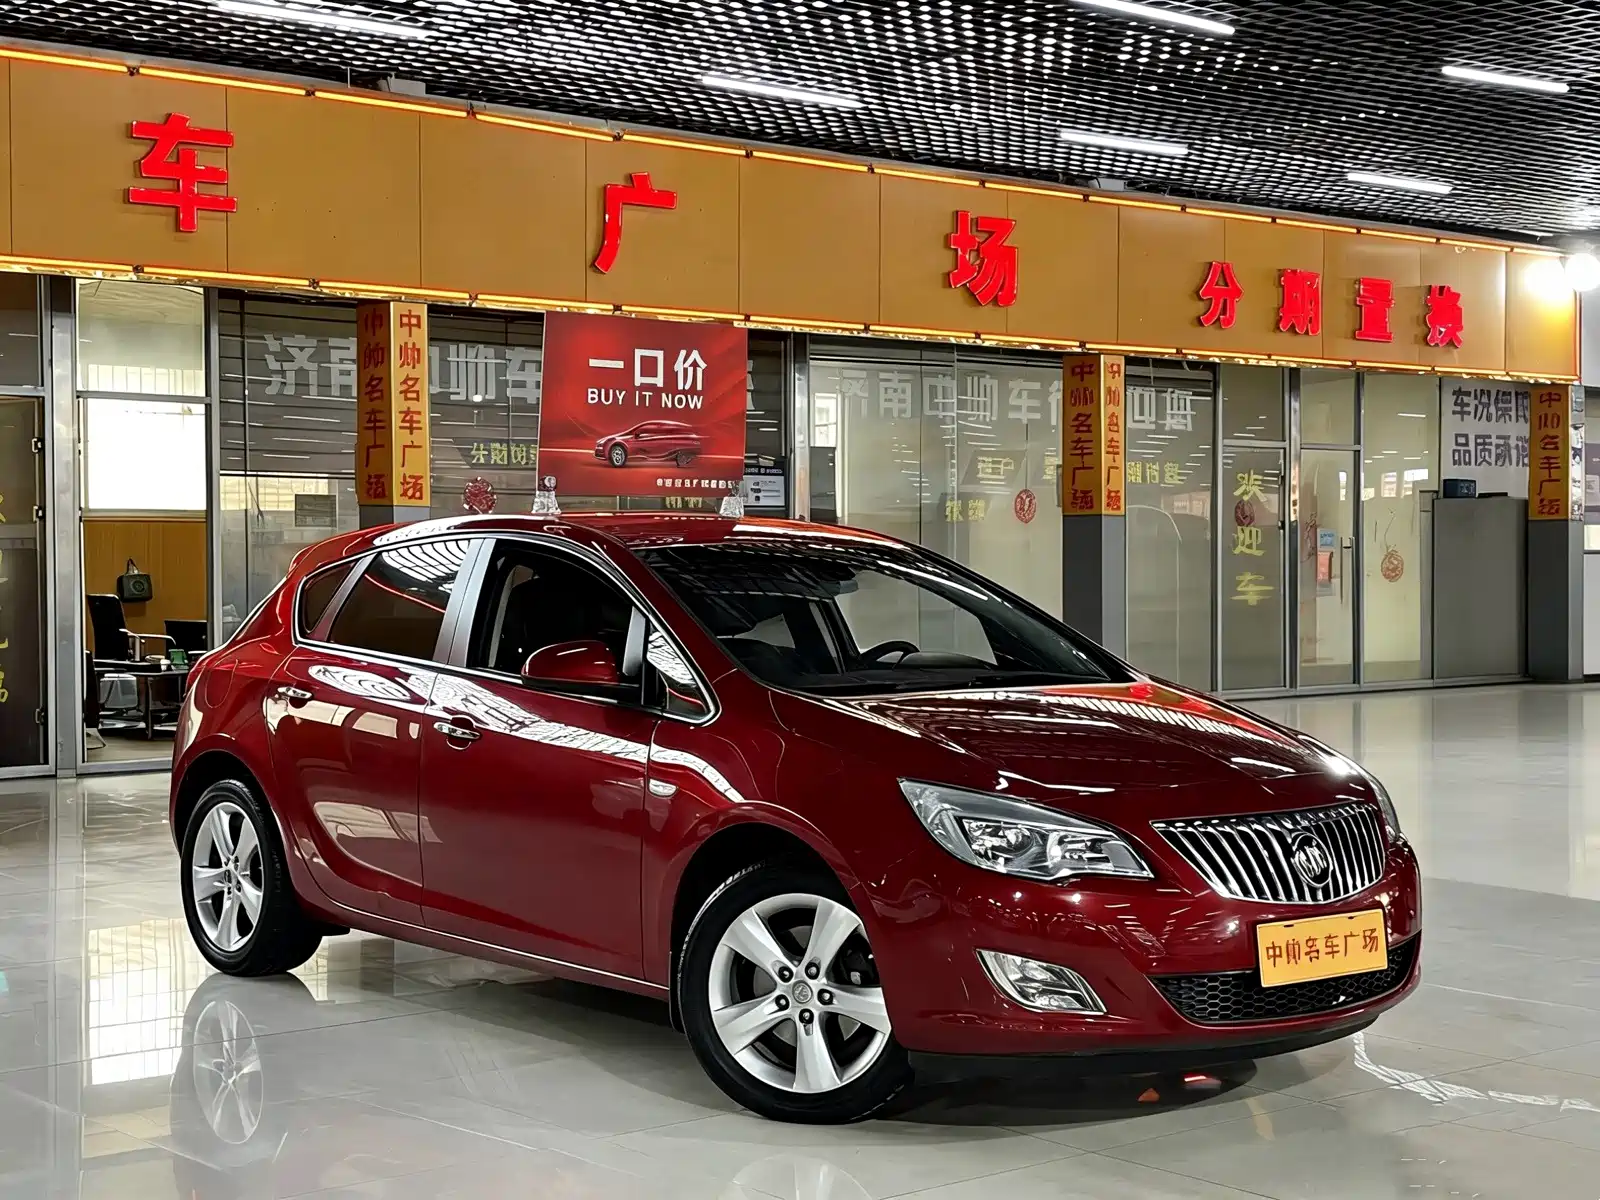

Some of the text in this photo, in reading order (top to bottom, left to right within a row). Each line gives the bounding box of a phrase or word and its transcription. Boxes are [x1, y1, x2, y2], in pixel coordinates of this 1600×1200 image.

[588, 348, 708, 391] 一口价
[399, 309, 424, 500] 中帅名车广场
[587, 388, 703, 410] BUY IT NOW
